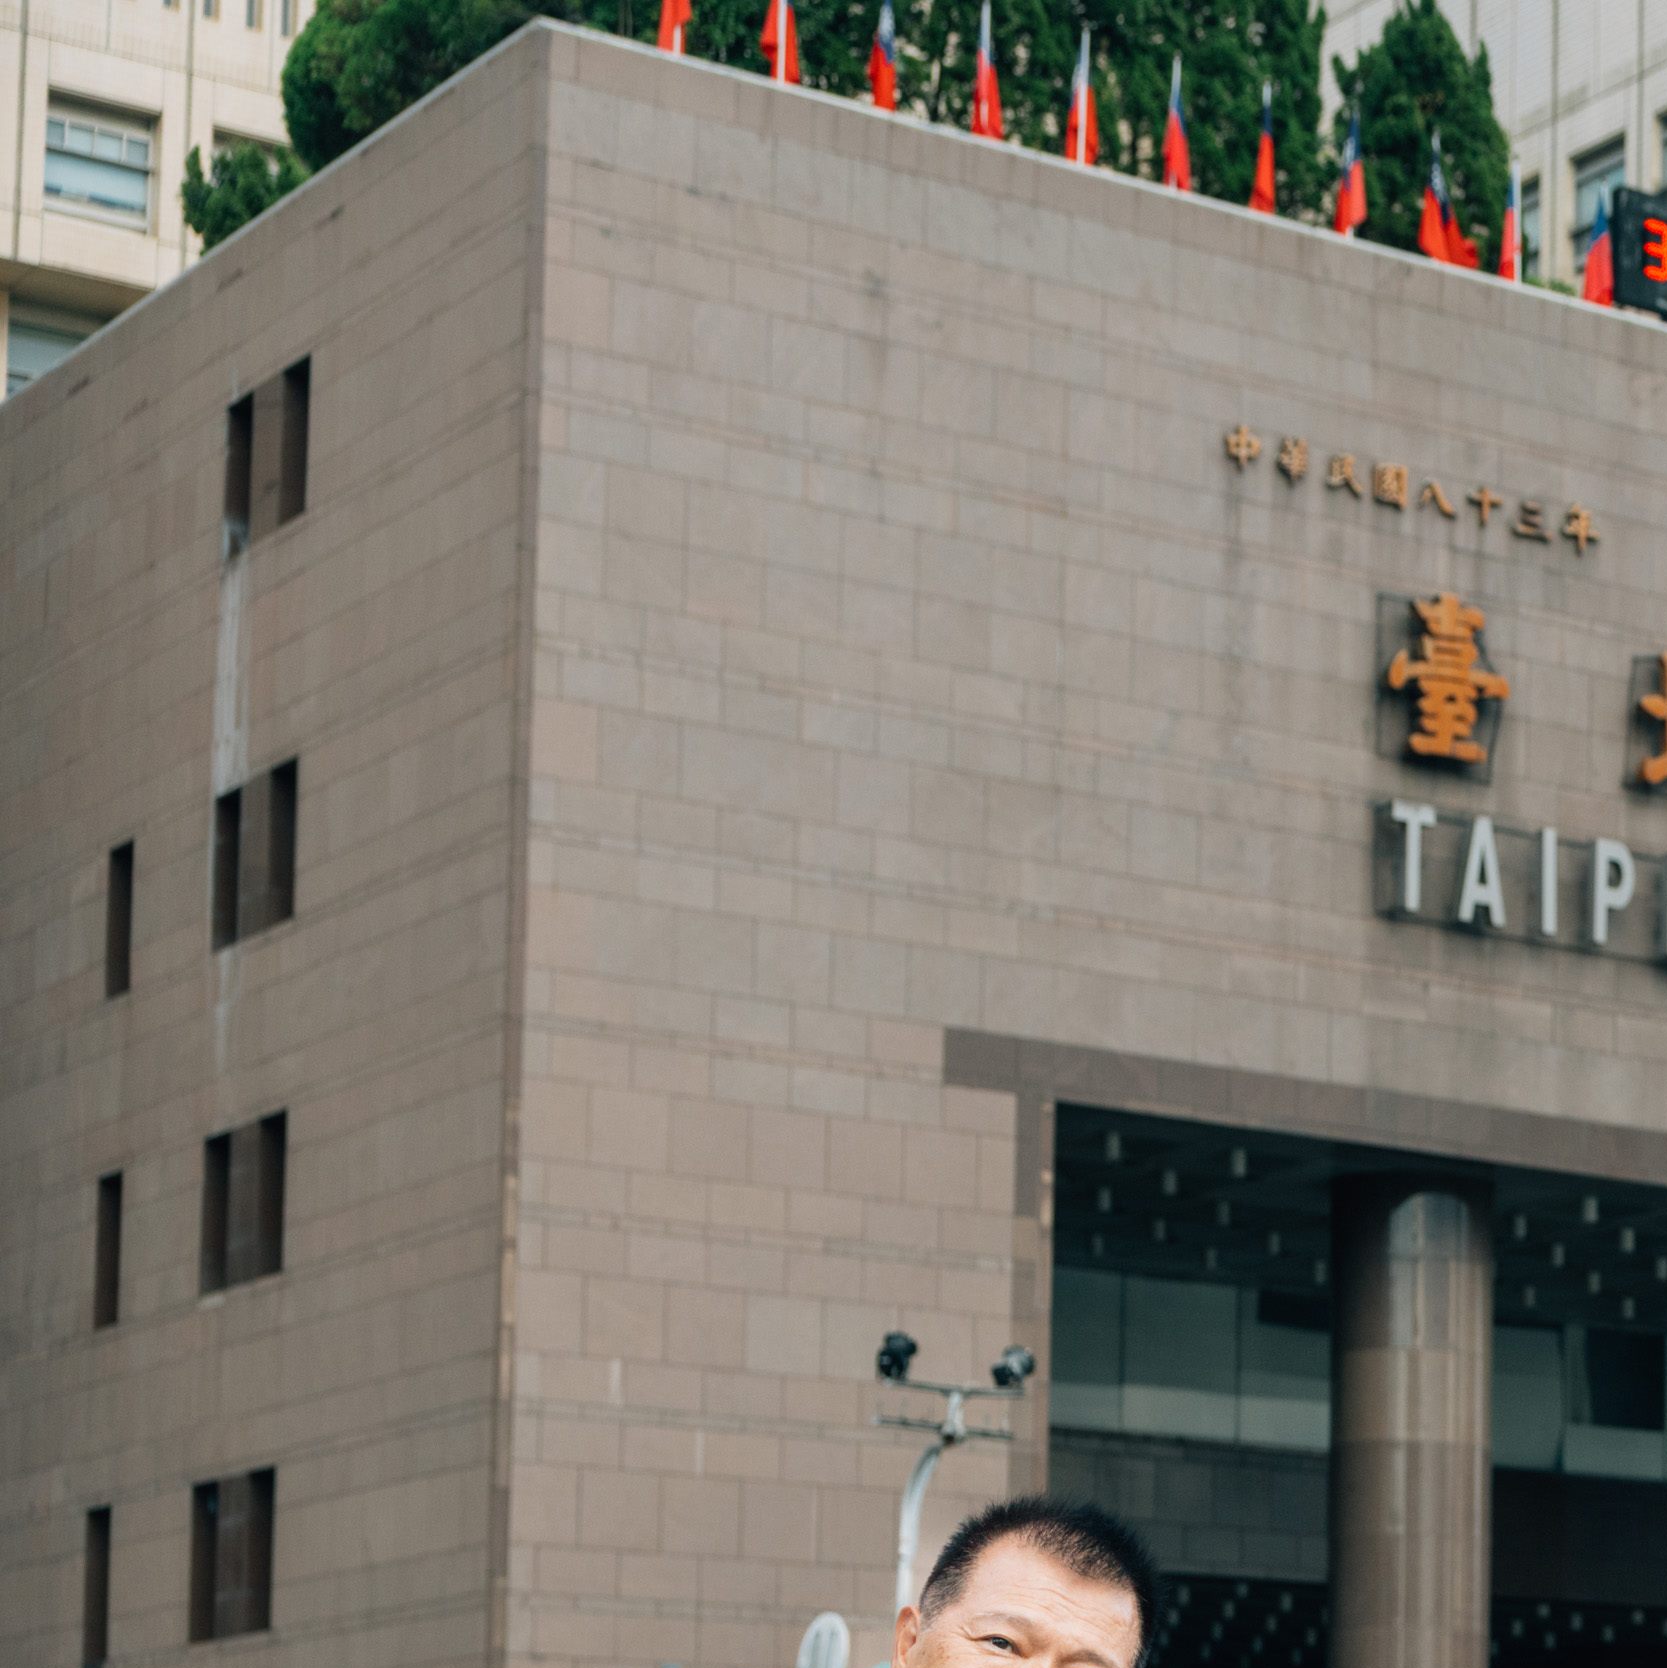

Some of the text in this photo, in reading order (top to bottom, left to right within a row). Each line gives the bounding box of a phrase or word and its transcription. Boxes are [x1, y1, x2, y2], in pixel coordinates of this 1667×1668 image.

[1225, 425, 1601, 556] 中華民國八十三年
